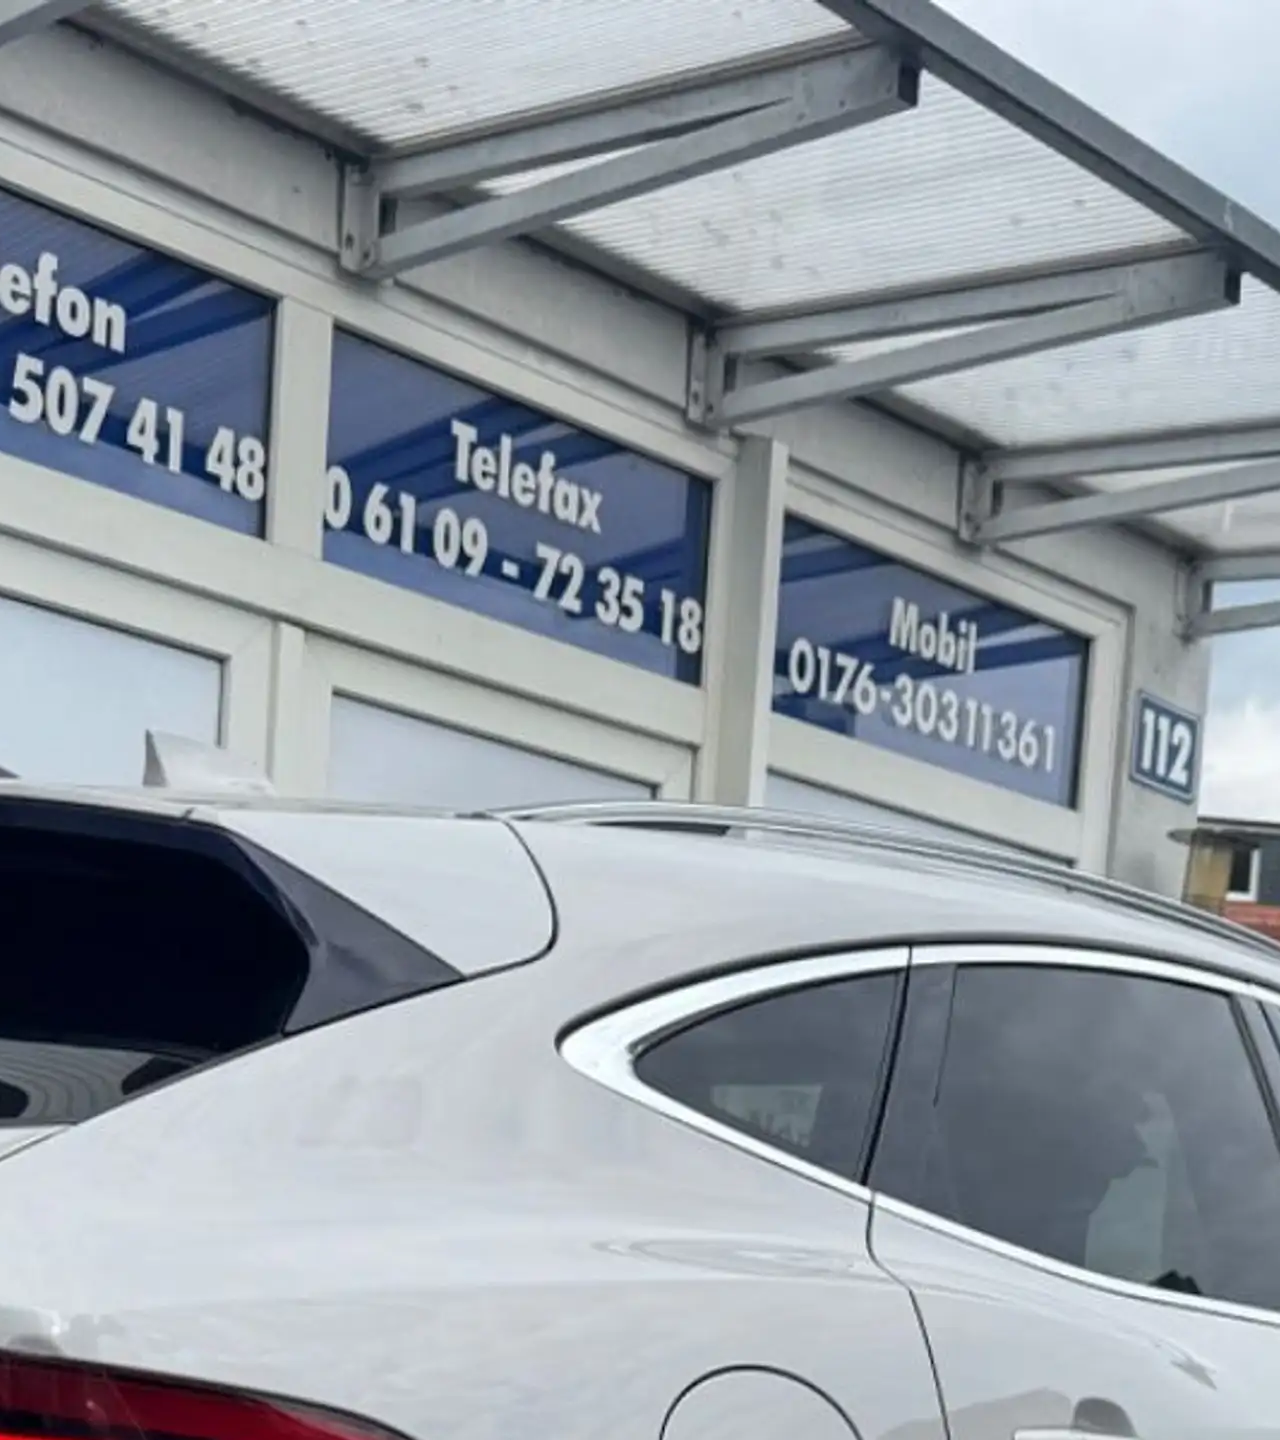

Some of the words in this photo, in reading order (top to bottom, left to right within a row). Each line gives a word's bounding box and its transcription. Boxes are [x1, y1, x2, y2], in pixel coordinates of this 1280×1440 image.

[9, 353, 115, 444] 507
[126, 398, 183, 473] 41
[205, 426, 266, 501] 48
[451, 419, 603, 534] Telefax
[323, 465, 353, 530] 0
[363, 483, 417, 554] 61
[433, 508, 488, 577] 09
[532, 542, 585, 614] 72
[595, 567, 645, 634] 35
[660, 588, 704, 654] 18
[889, 596, 978, 675] Mobil
[788, 637, 1056, 773] 0176-30311361
[1140, 709, 1195, 788] 112
